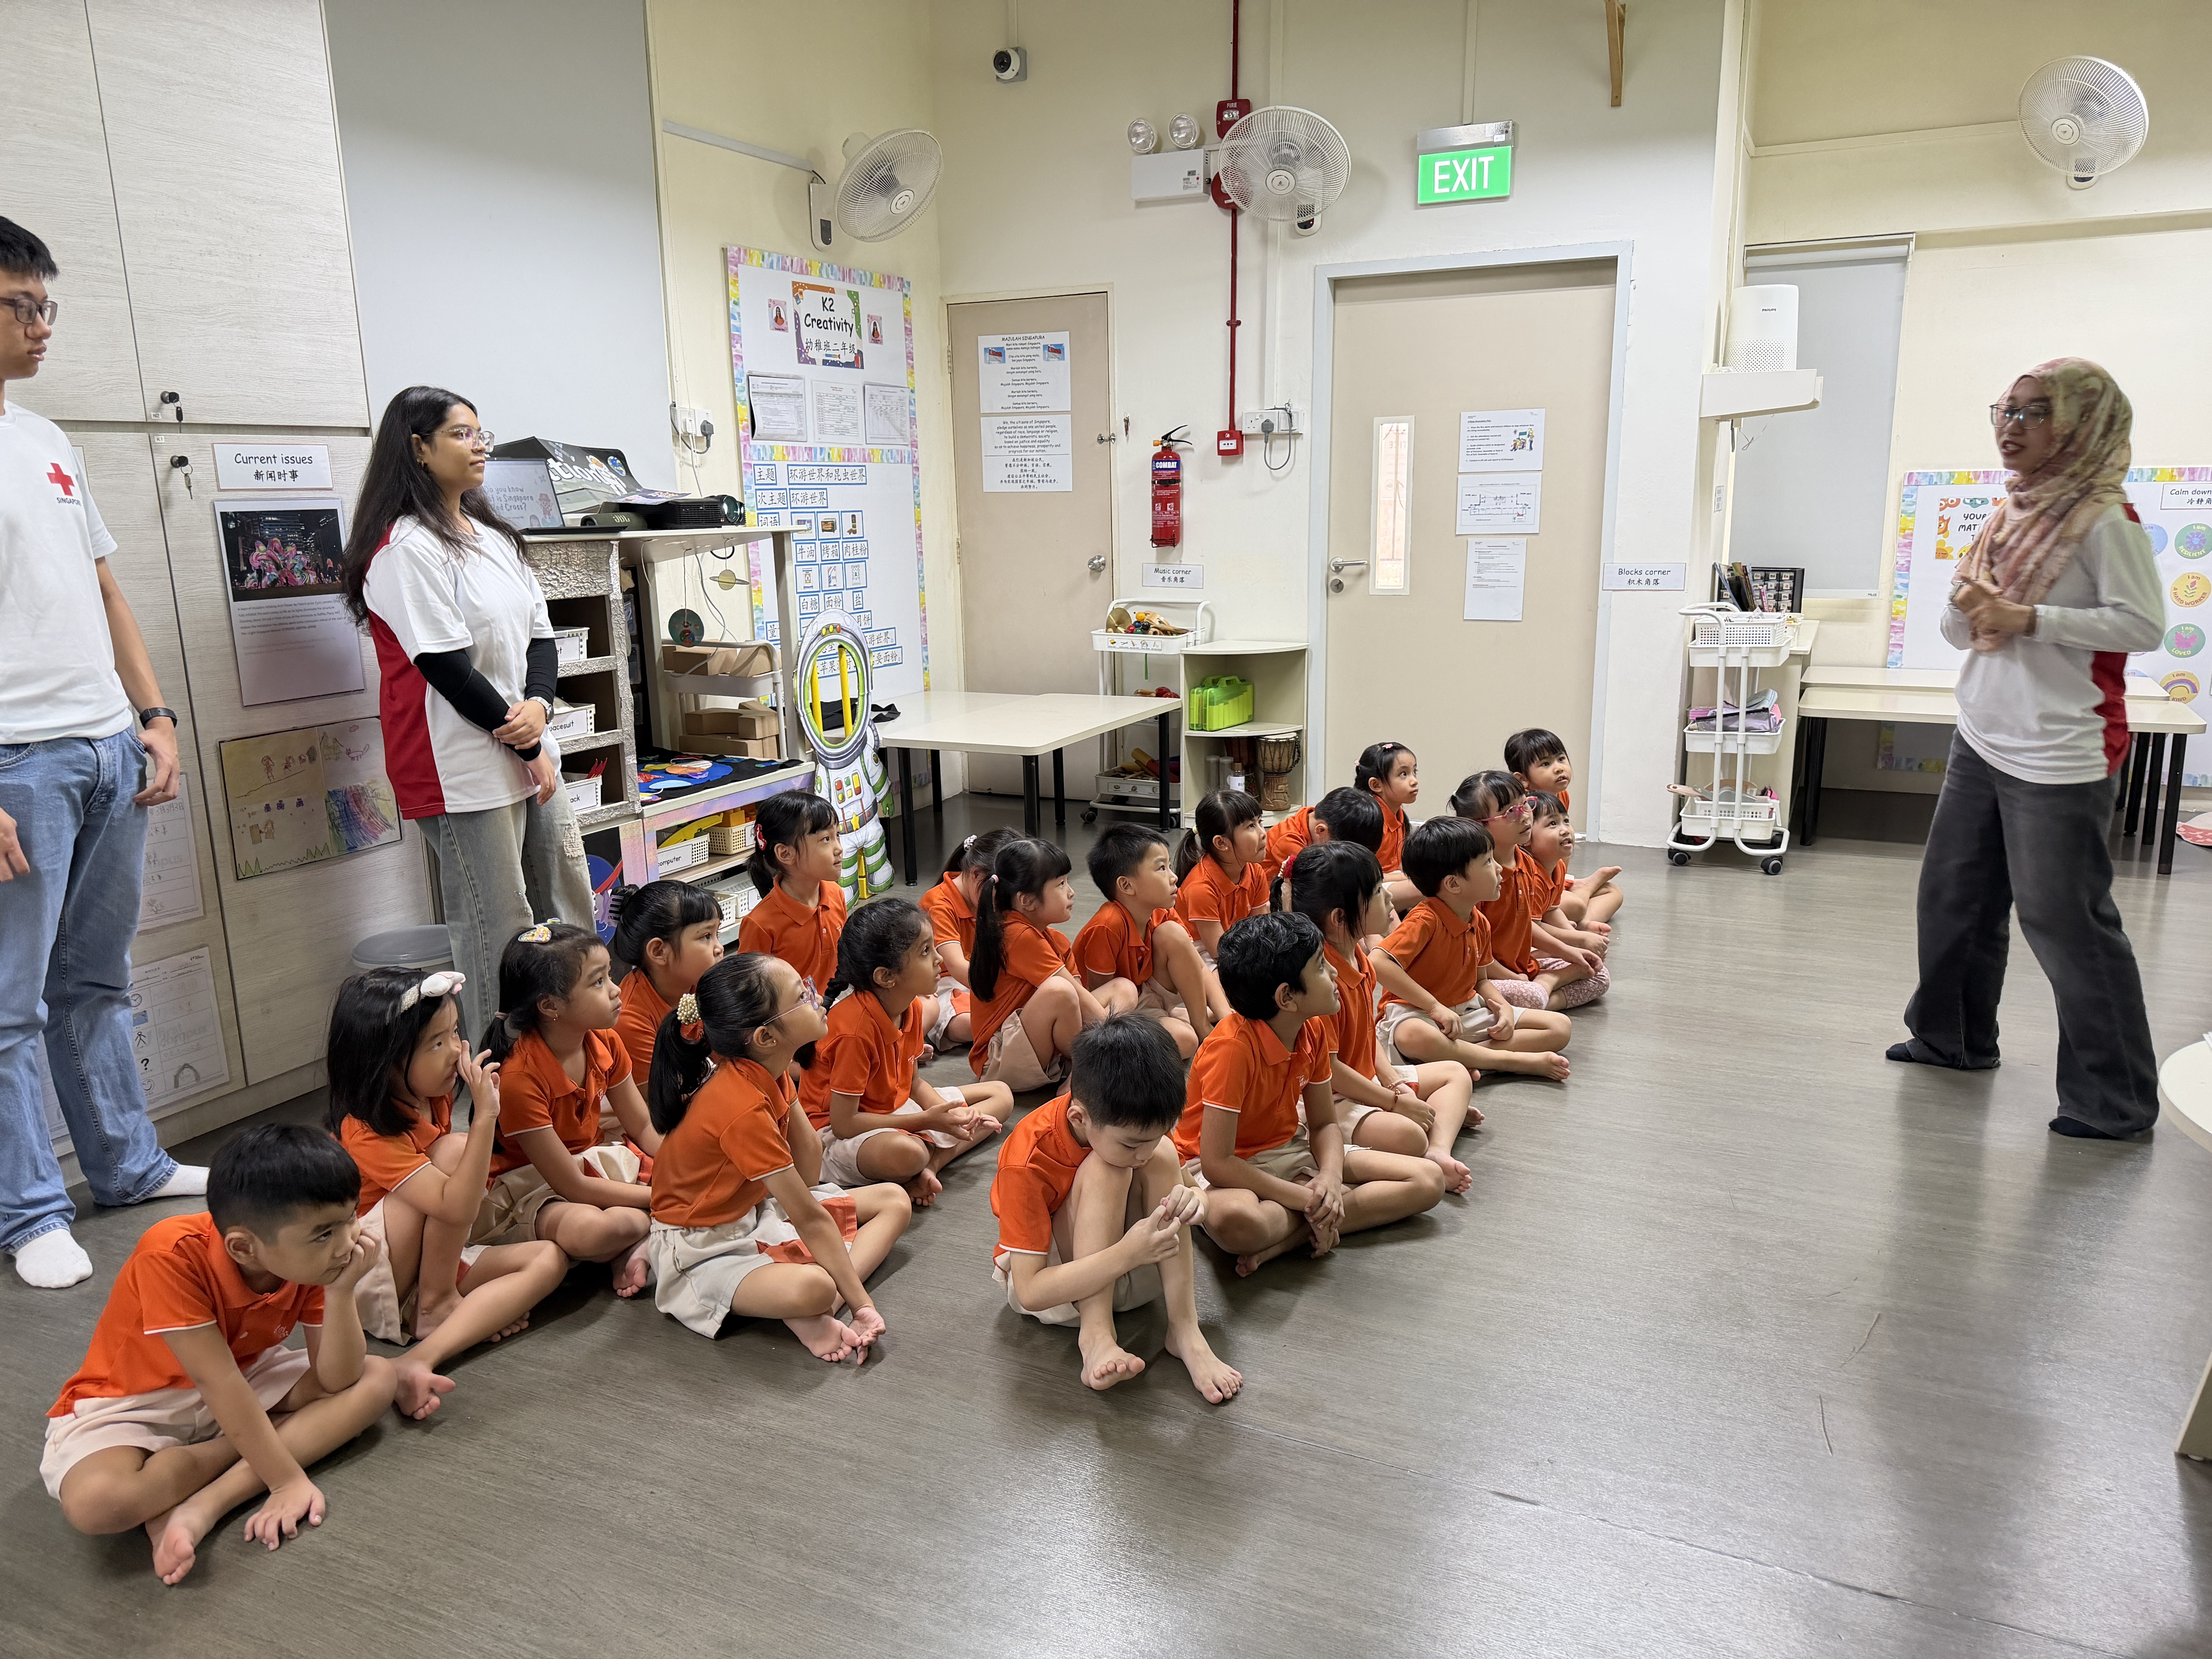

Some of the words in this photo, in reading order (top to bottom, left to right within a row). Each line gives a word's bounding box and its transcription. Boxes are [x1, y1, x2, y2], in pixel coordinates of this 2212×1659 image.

[1434, 156, 1494, 194] EXIT
[821, 296, 835, 312] K2
[804, 313, 854, 337] Creativity
[805, 338, 857, 355] 幼稚班二年级
[234, 453, 277, 464] Current
[282, 453, 313, 464] issues
[253, 469, 299, 482] 新闻时事
[756, 468, 775, 481] 主题
[790, 468, 866, 482] 环游世界和昆虫世界
[503, 494, 534, 503] Singapore
[758, 492, 786, 505] 次主题
[792, 491, 826, 505] 环游世界
[505, 502, 526, 511] Cross?
[759, 516, 778, 527] 词语
[798, 545, 814, 560] 牛油
[823, 544, 838, 558] 烤箱
[845, 543, 867, 556] 肉桂粉
[2179, 545, 2206, 557] RESILIENT
[802, 598, 818, 610] 白糖
[826, 595, 841, 608] 面粉
[855, 594, 862, 606] 盐
[2173, 591, 2184, 604] HARD
[2185, 592, 2207, 605] WORKER
[873, 651, 901, 665] 要面粉。
[549, 720, 574, 732] pacesuit
[658, 856, 682, 867] computer
